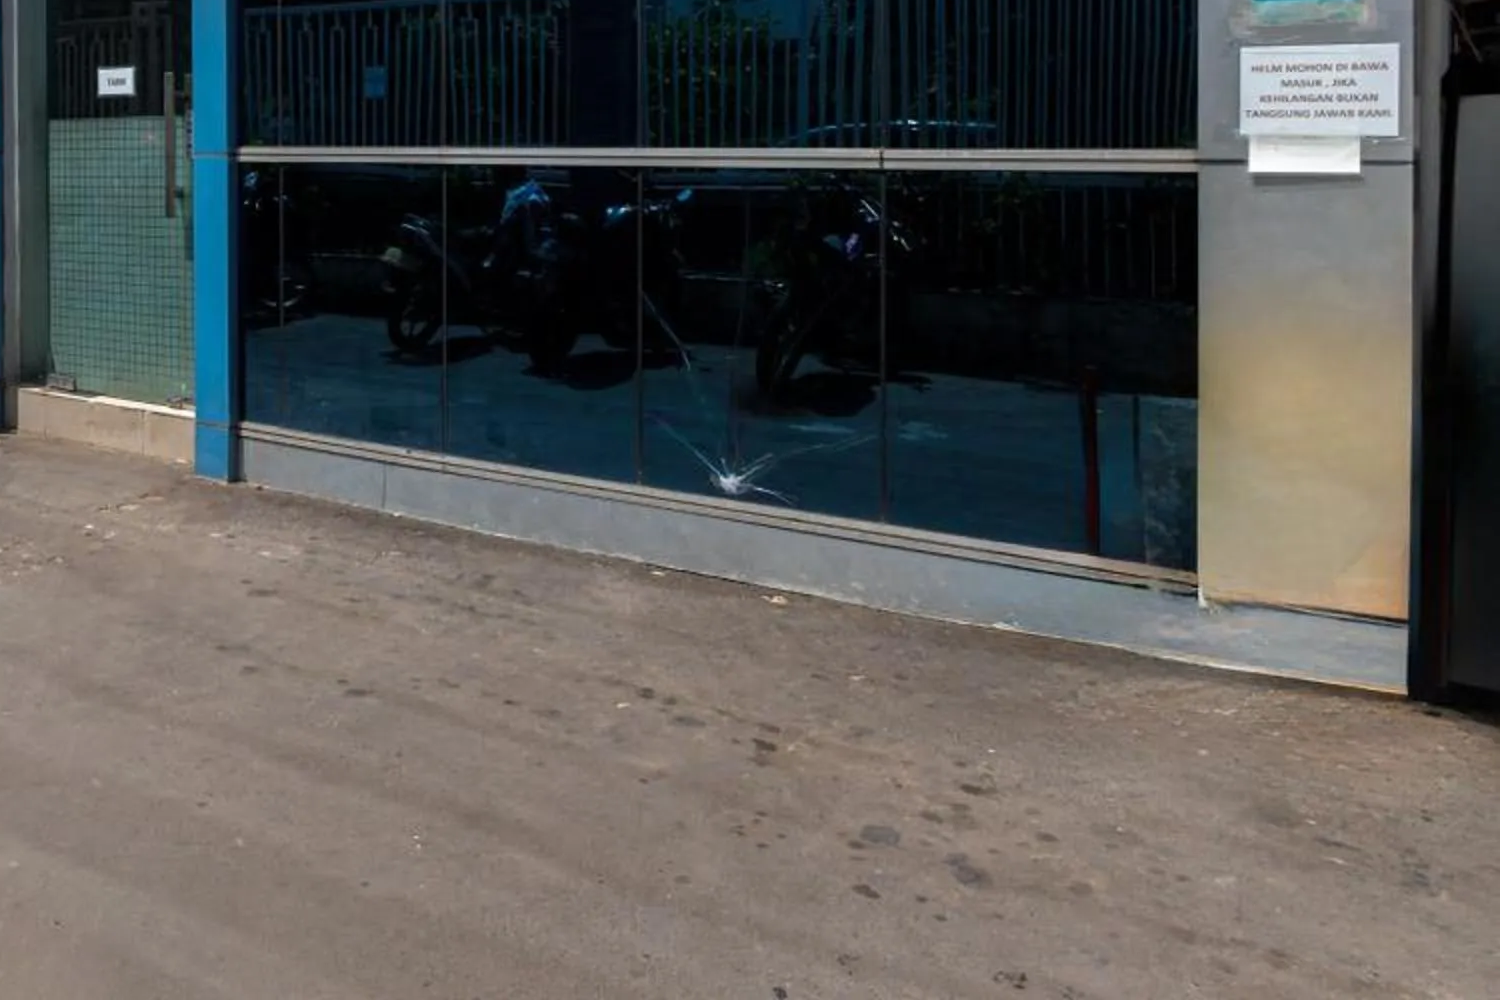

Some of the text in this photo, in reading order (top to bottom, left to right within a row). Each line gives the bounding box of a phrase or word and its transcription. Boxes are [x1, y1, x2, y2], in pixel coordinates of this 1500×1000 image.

[1251, 62, 1389, 73] HELM MOHON DI BAWA
[1280, 79, 1323, 88] MASUK
[1332, 78, 1358, 87] JIKA
[1259, 93, 1379, 103] KEHILANGAN BUKAN
[1245, 109, 1311, 119] TANGGUNG
[1313, 109, 1355, 118] JAWAB
